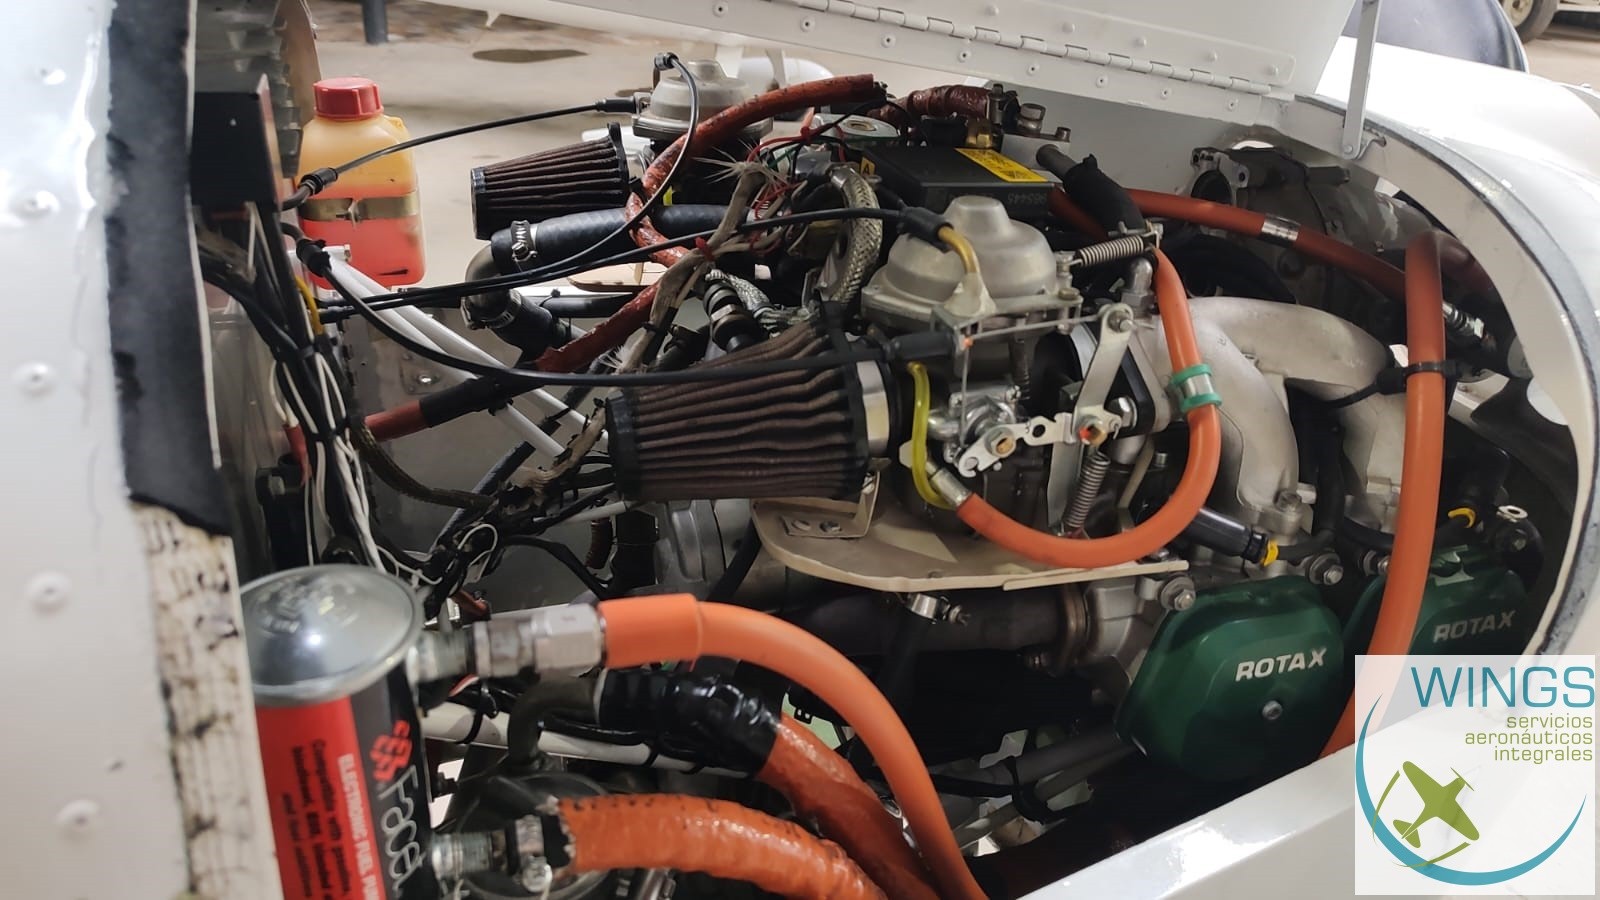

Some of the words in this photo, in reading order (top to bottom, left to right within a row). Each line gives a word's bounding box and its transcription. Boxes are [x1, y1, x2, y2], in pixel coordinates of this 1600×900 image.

[1235, 648, 1326, 682] ROTAX
[1433, 610, 1516, 643] ROTAX
[312, 738, 335, 812] Compatible
[328, 816, 342, 840] with
[337, 753, 368, 841] ELECTRONIC
[355, 839, 374, 876] FUEL
[378, 765, 427, 898] Facet
